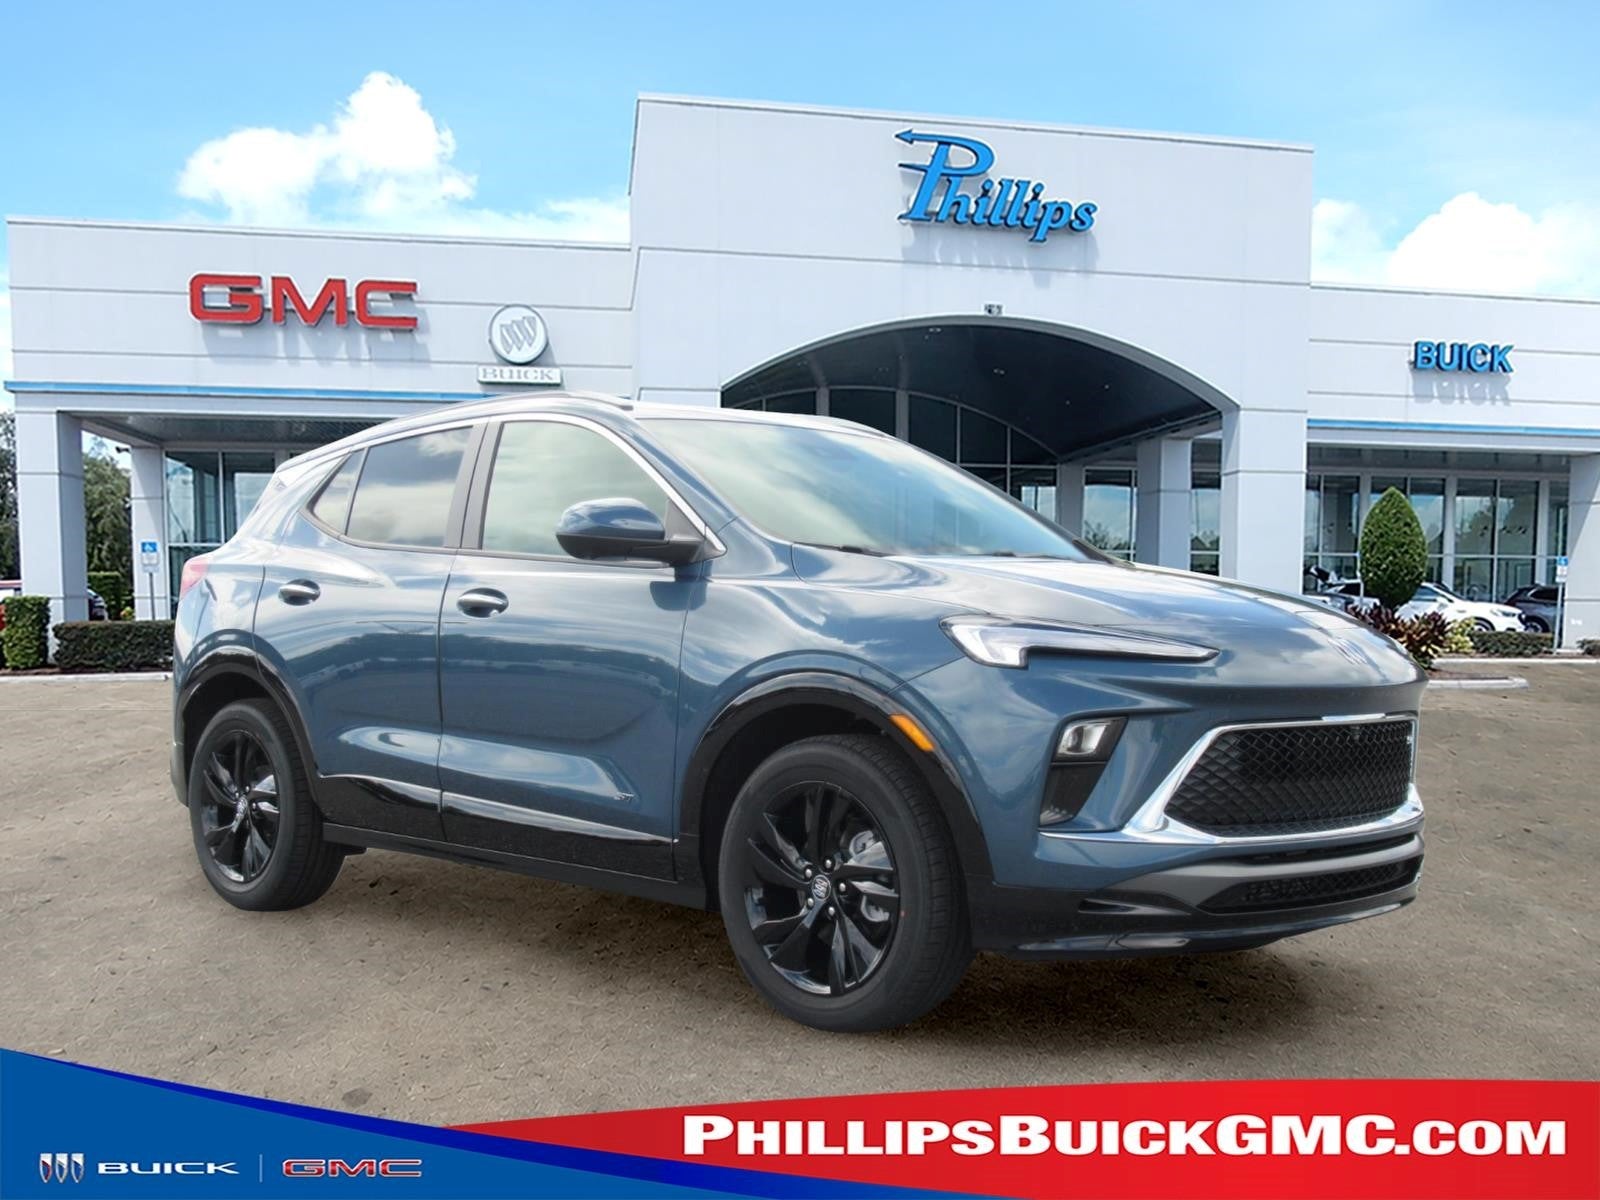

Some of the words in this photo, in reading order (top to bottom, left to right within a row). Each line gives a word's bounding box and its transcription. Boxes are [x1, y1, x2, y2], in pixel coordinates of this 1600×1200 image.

[895, 129, 1098, 243] Phillips
[189, 273, 418, 332] GMC
[482, 367, 553, 381] BUICK
[1413, 340, 1514, 373] BUICK
